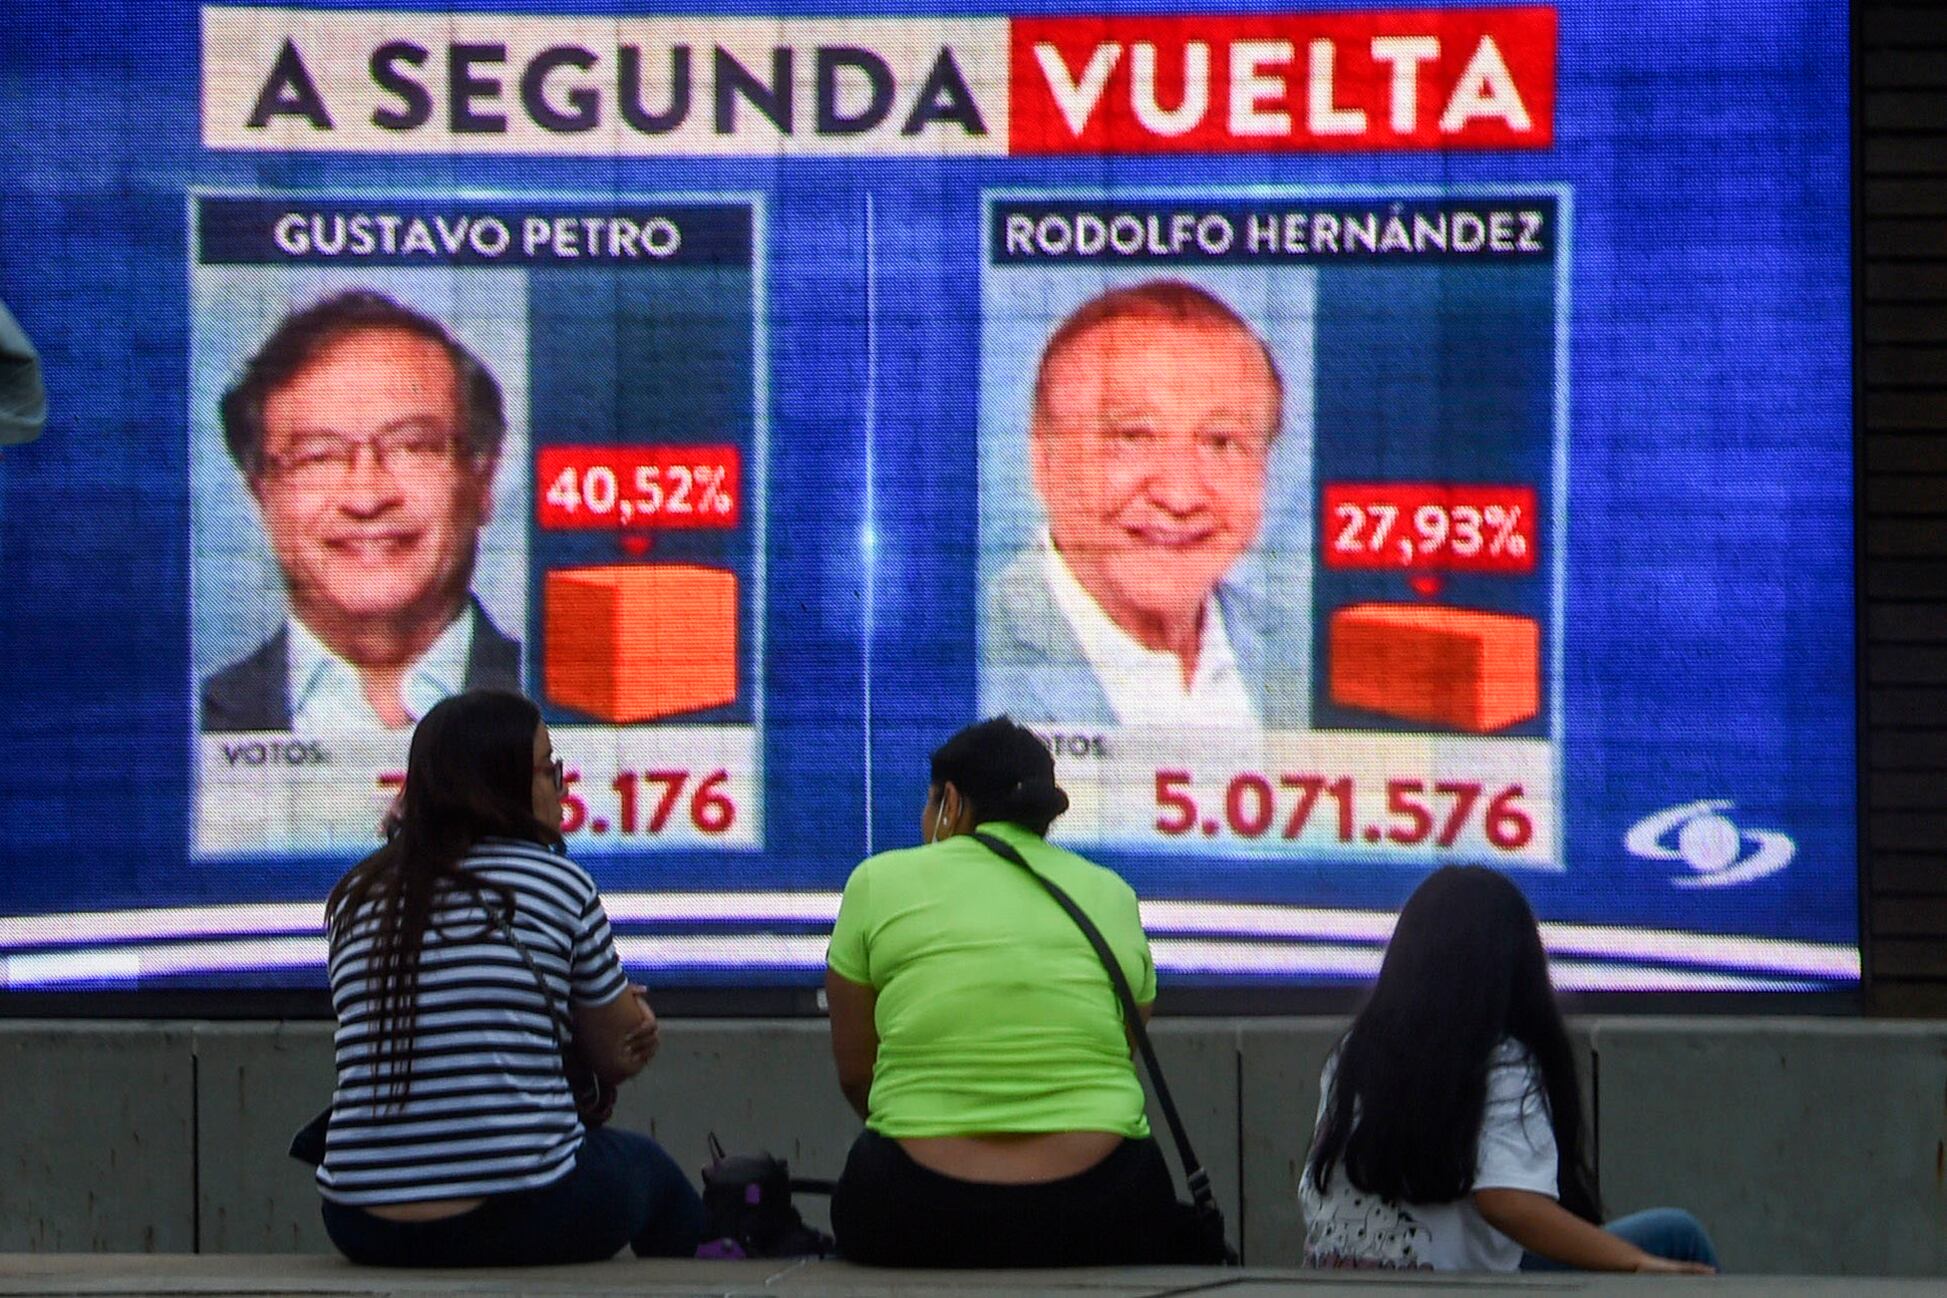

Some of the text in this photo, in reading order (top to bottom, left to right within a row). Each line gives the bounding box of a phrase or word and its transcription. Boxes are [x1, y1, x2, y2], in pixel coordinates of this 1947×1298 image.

[245, 34, 1532, 138] A SEGUNDA VUELTA
[273, 213, 682, 258] GUSTAVO PETRO
[1005, 203, 1544, 256] RODOLFO HERNÁNDEZ
[546, 465, 734, 526] 40,52%
[1334, 503, 1528, 567] 27,93%
[222, 740, 328, 767] VOTOS
[1036, 733, 1112, 761] TOS
[1155, 768, 1534, 851] 5.071.576
